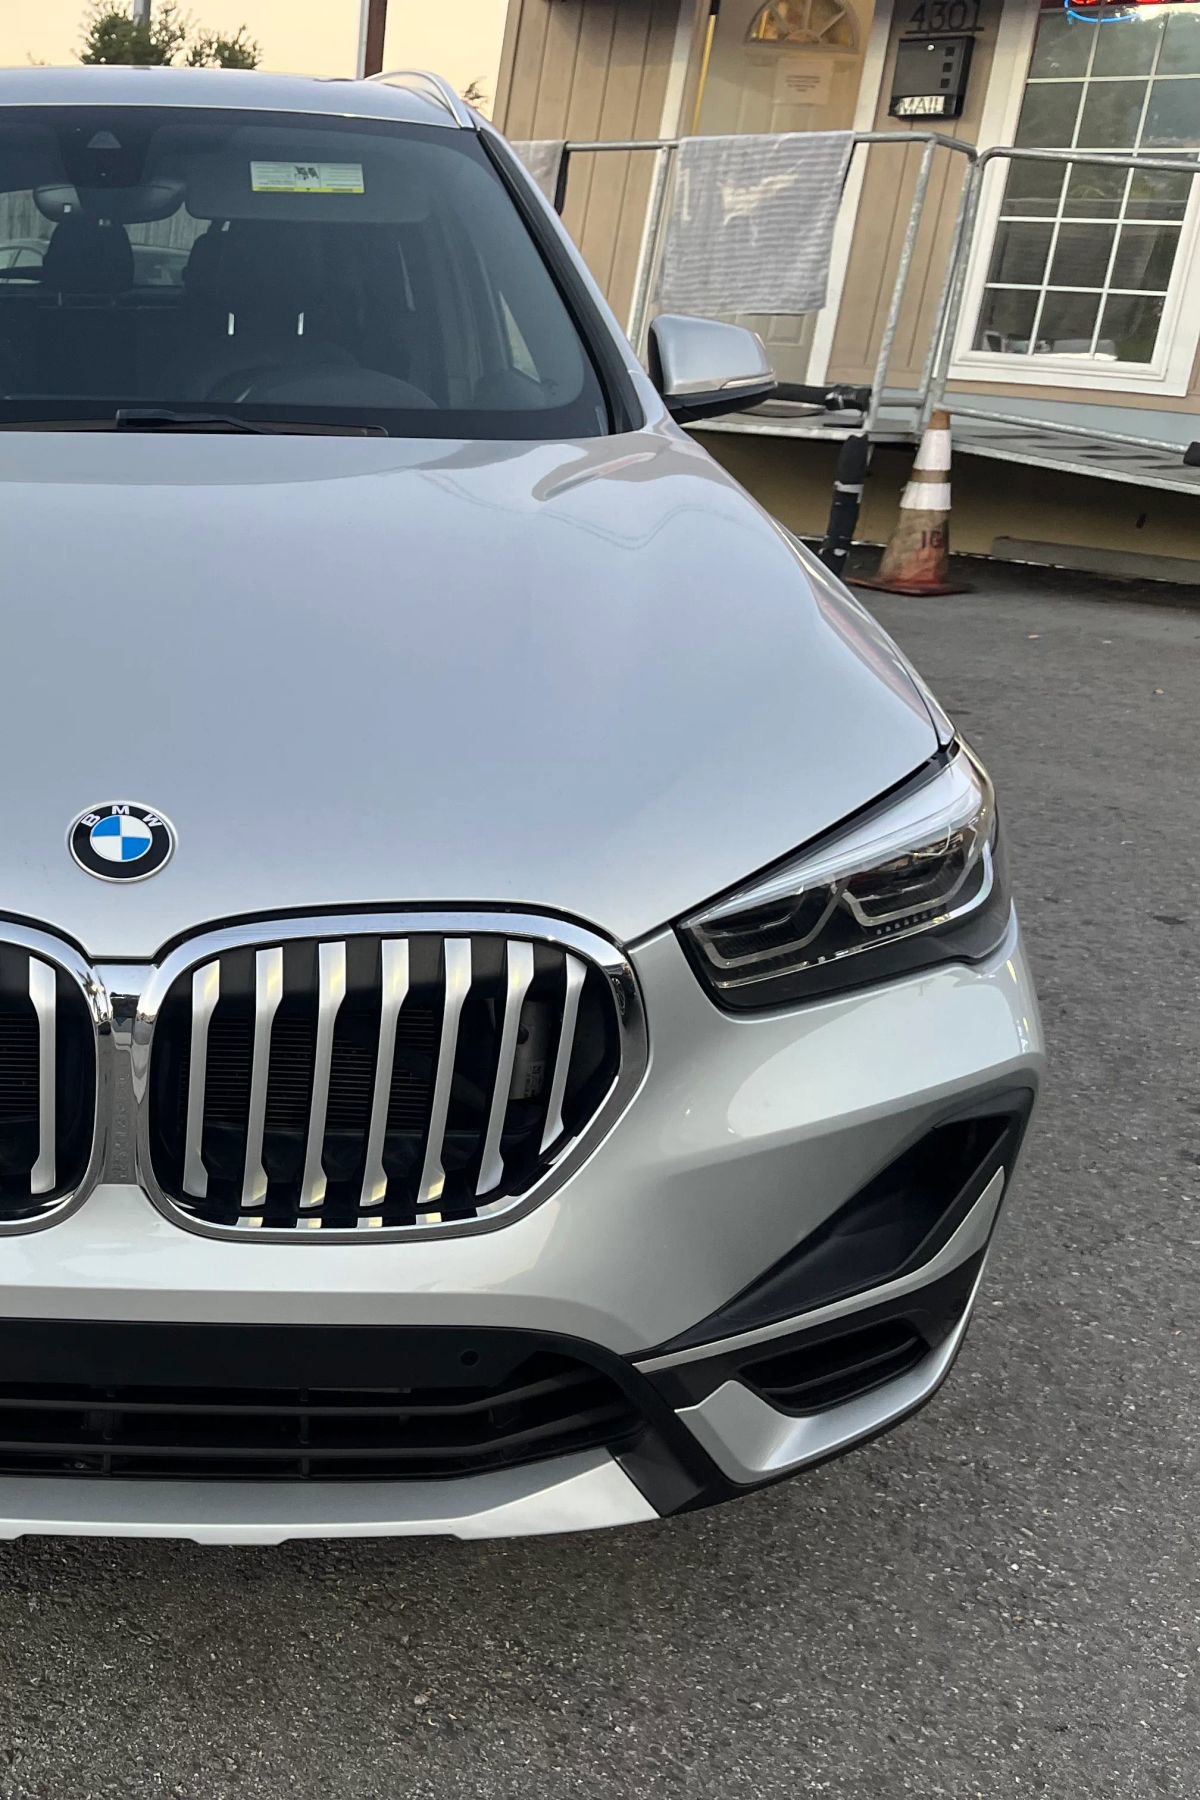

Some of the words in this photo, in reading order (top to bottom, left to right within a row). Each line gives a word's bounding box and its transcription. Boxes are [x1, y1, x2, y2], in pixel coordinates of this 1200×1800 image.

[909, 0, 981, 30] 4301
[899, 96, 944, 114] MAIL
[80, 805, 163, 828] BMW
